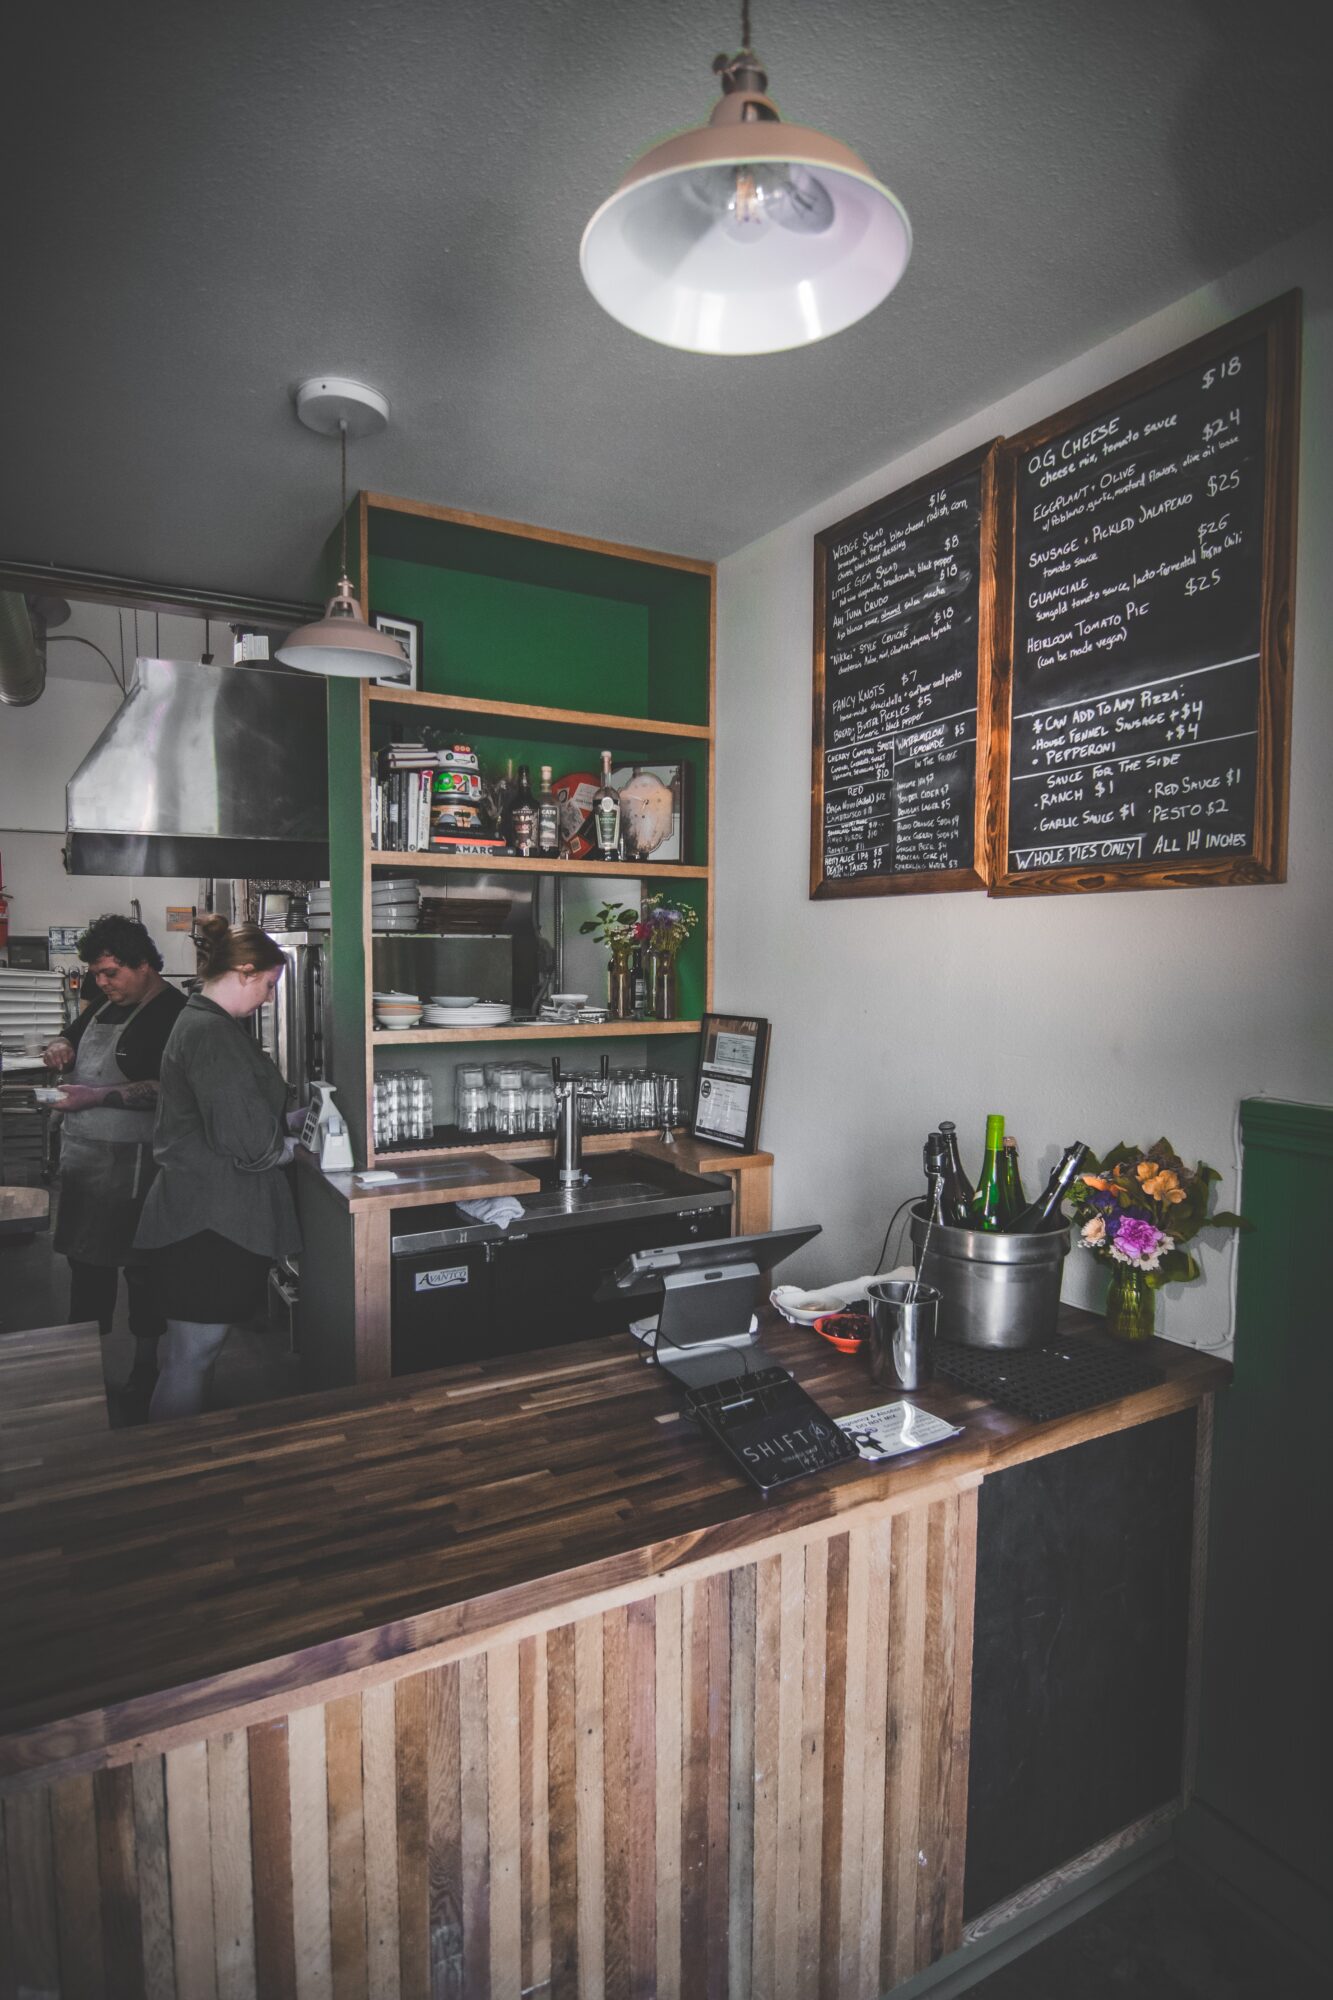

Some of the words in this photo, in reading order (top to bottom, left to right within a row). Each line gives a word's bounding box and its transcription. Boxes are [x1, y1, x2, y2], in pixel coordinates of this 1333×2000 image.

[1062, 417, 1120, 459] CHEESE
[1202, 356, 1242, 389] $18
[1040, 464, 1076, 487] cheese
[1103, 432, 1139, 456] tomato
[1144, 414, 1178, 435] sauce
[1183, 453, 1200, 467] olive
[1203, 445, 1215, 459] oil
[1219, 436, 1240, 449] base
[1033, 485, 1089, 520] EGGPLANT
[1100, 464, 1136, 488] OLIVE
[1202, 409, 1240, 442] $24
[833, 540, 859, 560] WEDGE
[863, 528, 883, 546] SALAD
[928, 489, 946, 507] $16
[1029, 539, 1079, 567] SAUSAGE
[1093, 518, 1134, 543] PICKLED
[1139, 494, 1192, 523] JALAPENO
[1207, 470, 1240, 497] $25
[832, 583, 851, 600] LITTLE
[855, 572, 872, 587] GEM
[876, 562, 898, 580] SALAD
[944, 535, 959, 551] $8
[918, 560, 932, 573] black
[934, 555, 954, 571] pepper
[1028, 578, 1088, 608] GUANCIALE
[1197, 514, 1230, 543] $26
[1043, 563, 1071, 578] tomato
[1074, 553, 1098, 566] sauce
[833, 616, 843, 628] AHI
[845, 609, 862, 620] TUNA
[864, 596, 888, 612] CRUDO
[940, 564, 957, 581] $18
[1072, 591, 1099, 608] tomato
[1027, 629, 1072, 653] HEIRLOOM
[1075, 614, 1121, 636] TOMATO
[1126, 602, 1150, 621] PIE
[1184, 569, 1221, 596] $25
[859, 641, 876, 654] STYLE
[934, 607, 954, 625] $18
[1057, 650, 1068, 661] be
[1070, 640, 1092, 656] made
[1096, 627, 1127, 650] vegan)
[945, 668, 962, 688] pesto
[833, 695, 856, 715] FANCY
[858, 683, 885, 703] KNOTS
[901, 670, 917, 686] $7
[880, 705, 910, 723] PICKLES
[917, 694, 932, 708] $5
[885, 720, 900, 731] black
[902, 712, 924, 728] pepper
[1072, 708, 1094, 724] ADD
[1099, 701, 1111, 715] TO
[1113, 698, 1135, 712] ANY
[954, 723, 965, 737] $5
[1070, 727, 1109, 743] FENNEL
[1115, 712, 1165, 732] SAUSAGE
[827, 751, 850, 763] CHERRY
[909, 738, 944, 757] LEMONADE
[1046, 742, 1116, 765] PEPPERONI
[876, 769, 889, 780] $10
[915, 760, 922, 768] IN
[923, 757, 934, 765] THE
[1047, 771, 1083, 788] SAUCE
[1093, 766, 1113, 778] FOR
[1119, 759, 1141, 772] THE
[1146, 754, 1181, 769] SIDE
[848, 785, 863, 795] RED
[1040, 789, 1083, 810] RANCH
[1094, 781, 1114, 798] $1
[1155, 781, 1178, 799] RED
[1182, 776, 1220, 794] SAUCE
[1226, 768, 1241, 787] $1
[921, 801, 940, 810] LAGER
[941, 798, 950, 809] $5
[1040, 815, 1079, 831] GARLIC
[1083, 811, 1114, 825] SAUCE
[1120, 803, 1135, 821] $1
[1152, 803, 1201, 822] PESTO
[1205, 799, 1229, 817] $2
[858, 851, 868, 861] IPA
[874, 848, 882, 857] $8
[1153, 835, 1180, 854] ALL
[1188, 829, 1200, 850] 14
[1206, 833, 1246, 848] INCHES
[827, 864, 844, 876] DEATH
[850, 861, 867, 871] TAXES
[873, 858, 881, 868] $7
[1016, 847, 1064, 870] WHOLE
[1069, 845, 1096, 863] PIES
